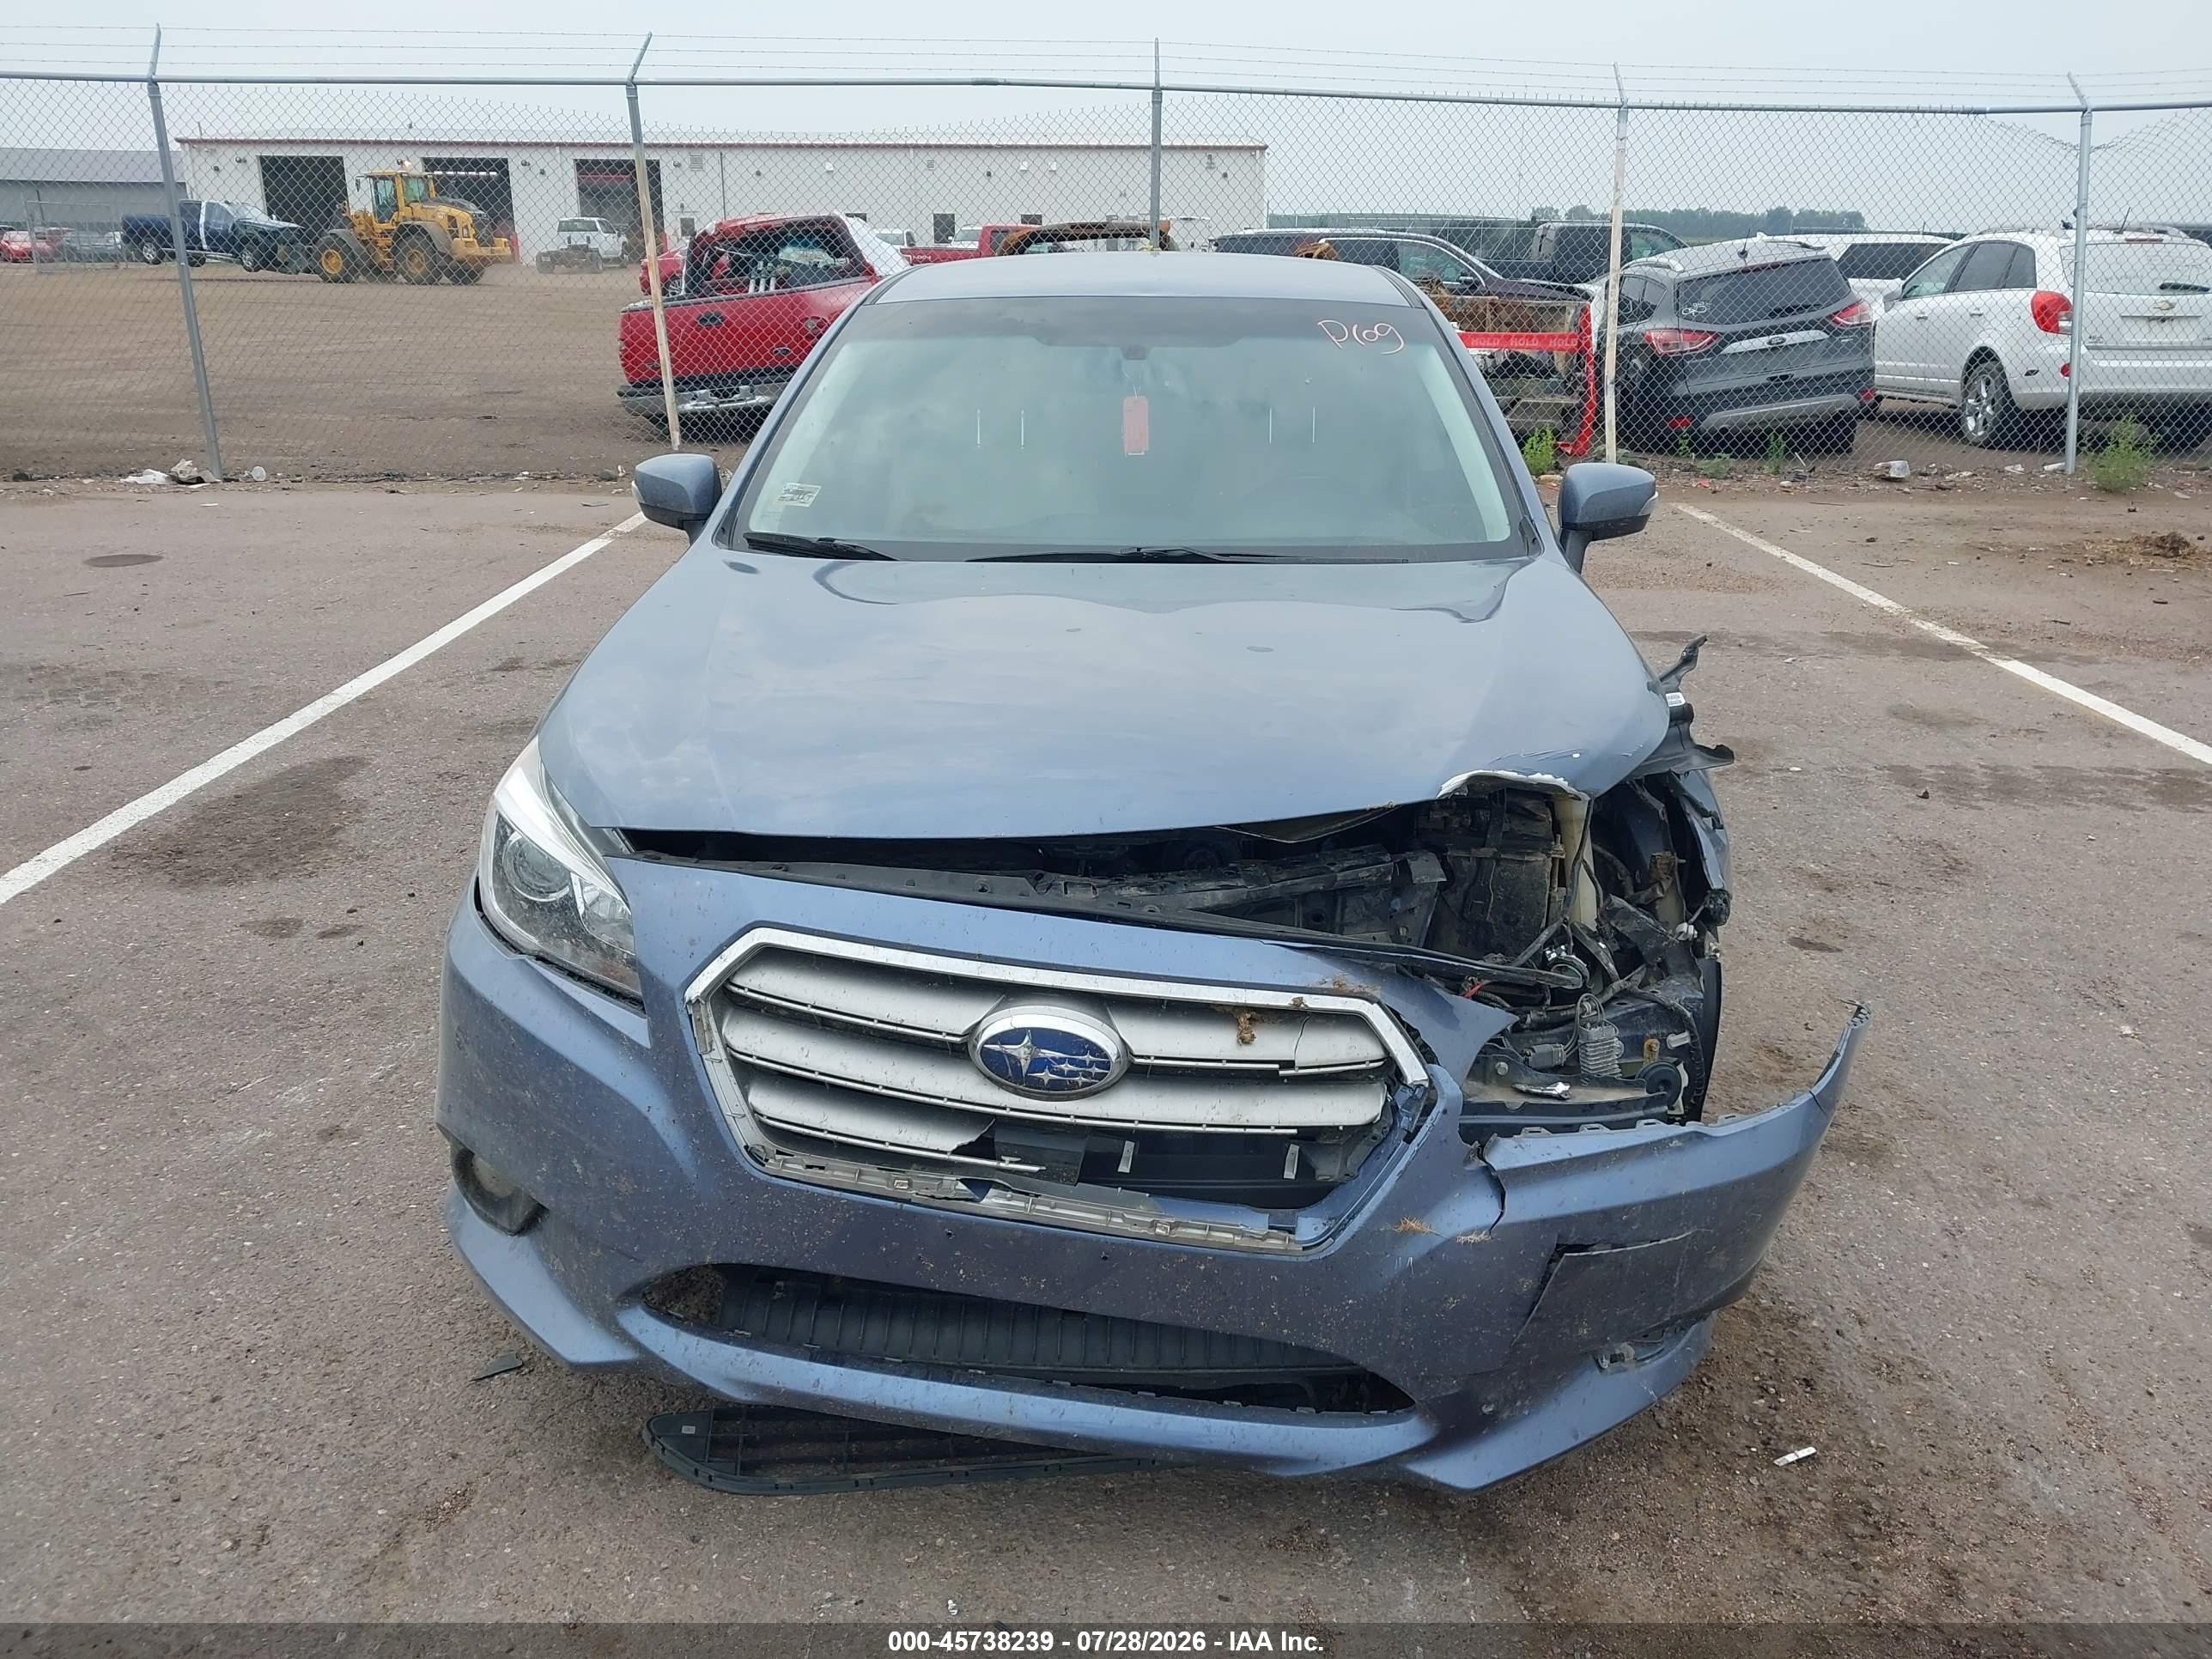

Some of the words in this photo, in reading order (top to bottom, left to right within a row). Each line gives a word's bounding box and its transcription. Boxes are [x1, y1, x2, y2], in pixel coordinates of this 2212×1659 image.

[1470, 337, 1500, 347] HOLD
[1510, 336, 1539, 346] HOLD
[1548, 337, 1578, 347] HOLD
